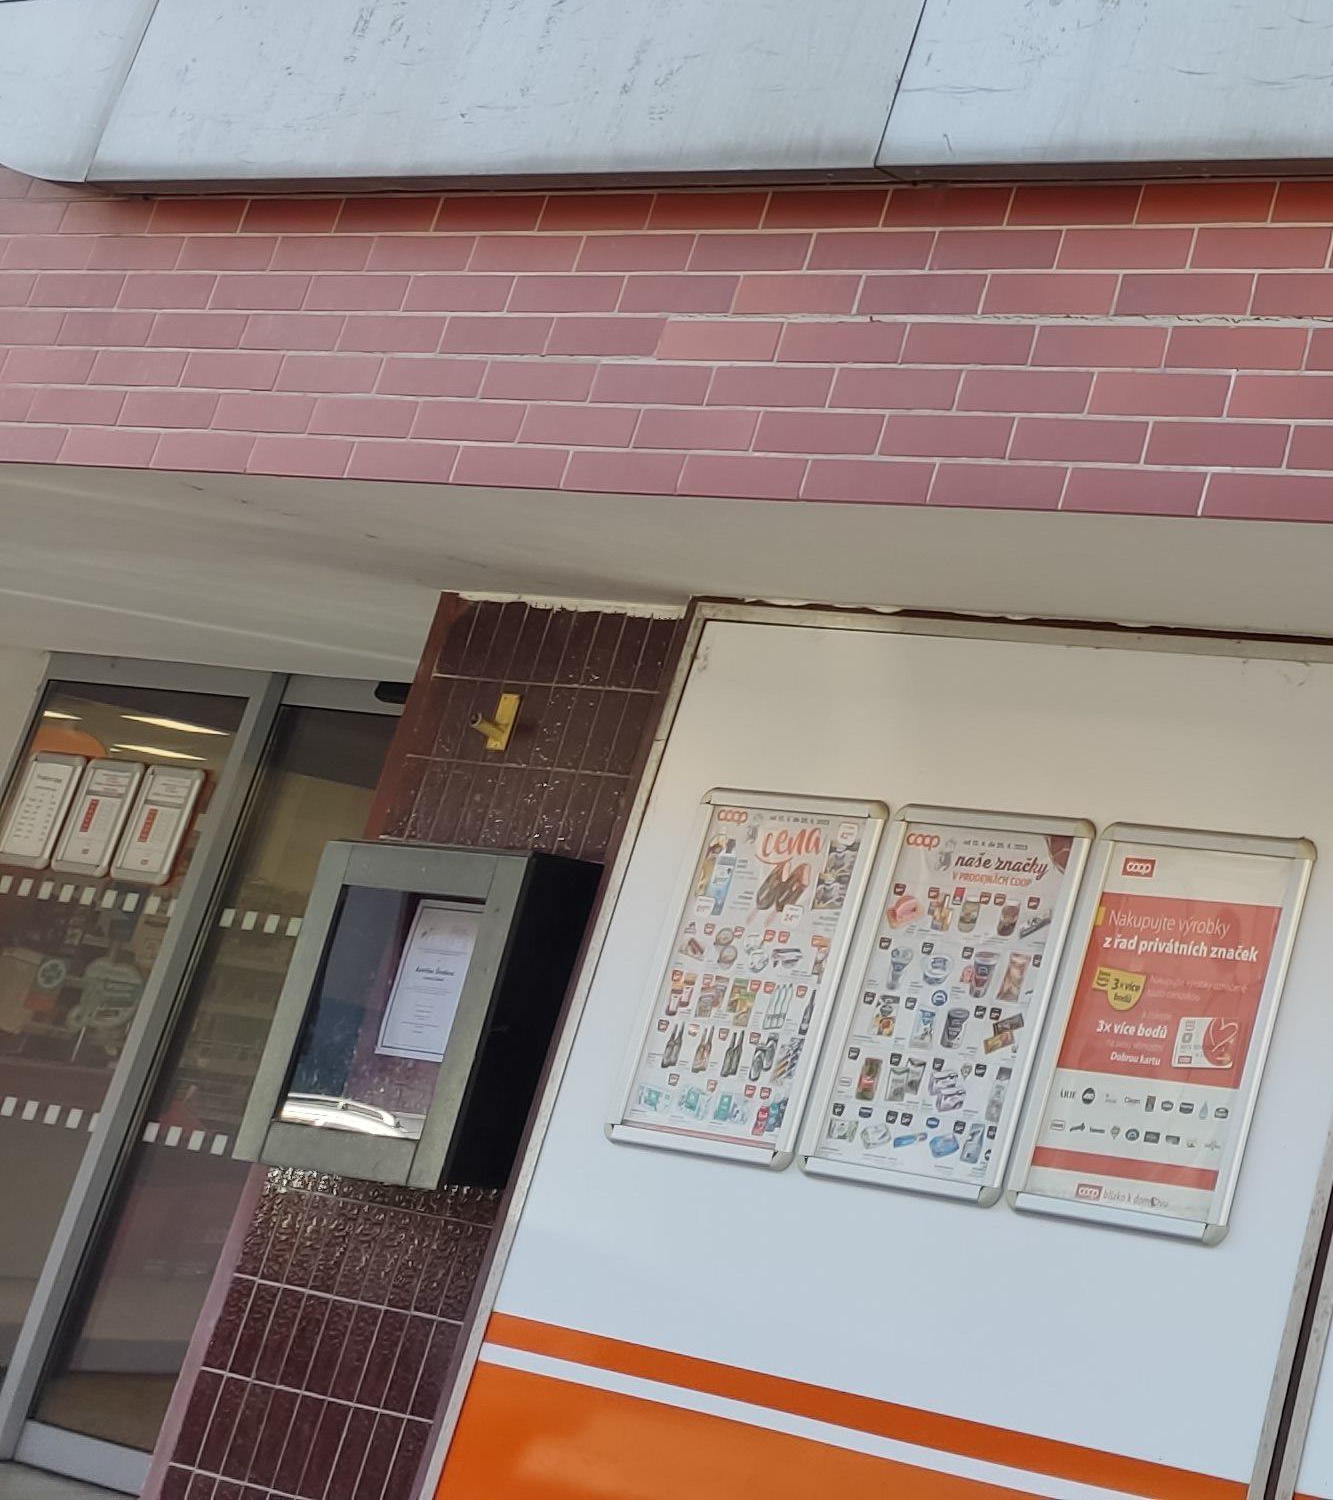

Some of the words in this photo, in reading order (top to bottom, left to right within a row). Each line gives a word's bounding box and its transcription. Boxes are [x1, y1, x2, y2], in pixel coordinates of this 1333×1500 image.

[955, 853, 992, 869] naše
[994, 856, 1048, 880] značky
[1126, 861, 1151, 875] coop
[1109, 910, 1175, 931] Nakupujte
[1179, 915, 1230, 940] výrobky
[1103, 937, 1112, 949] z
[1114, 934, 1137, 950] řad
[1138, 935, 1208, 958] privátních
[1209, 945, 1259, 962] značek
[1113, 1021, 1135, 1036] více
[1137, 1023, 1168, 1039] bodů
[1140, 1054, 1160, 1066] kartu
